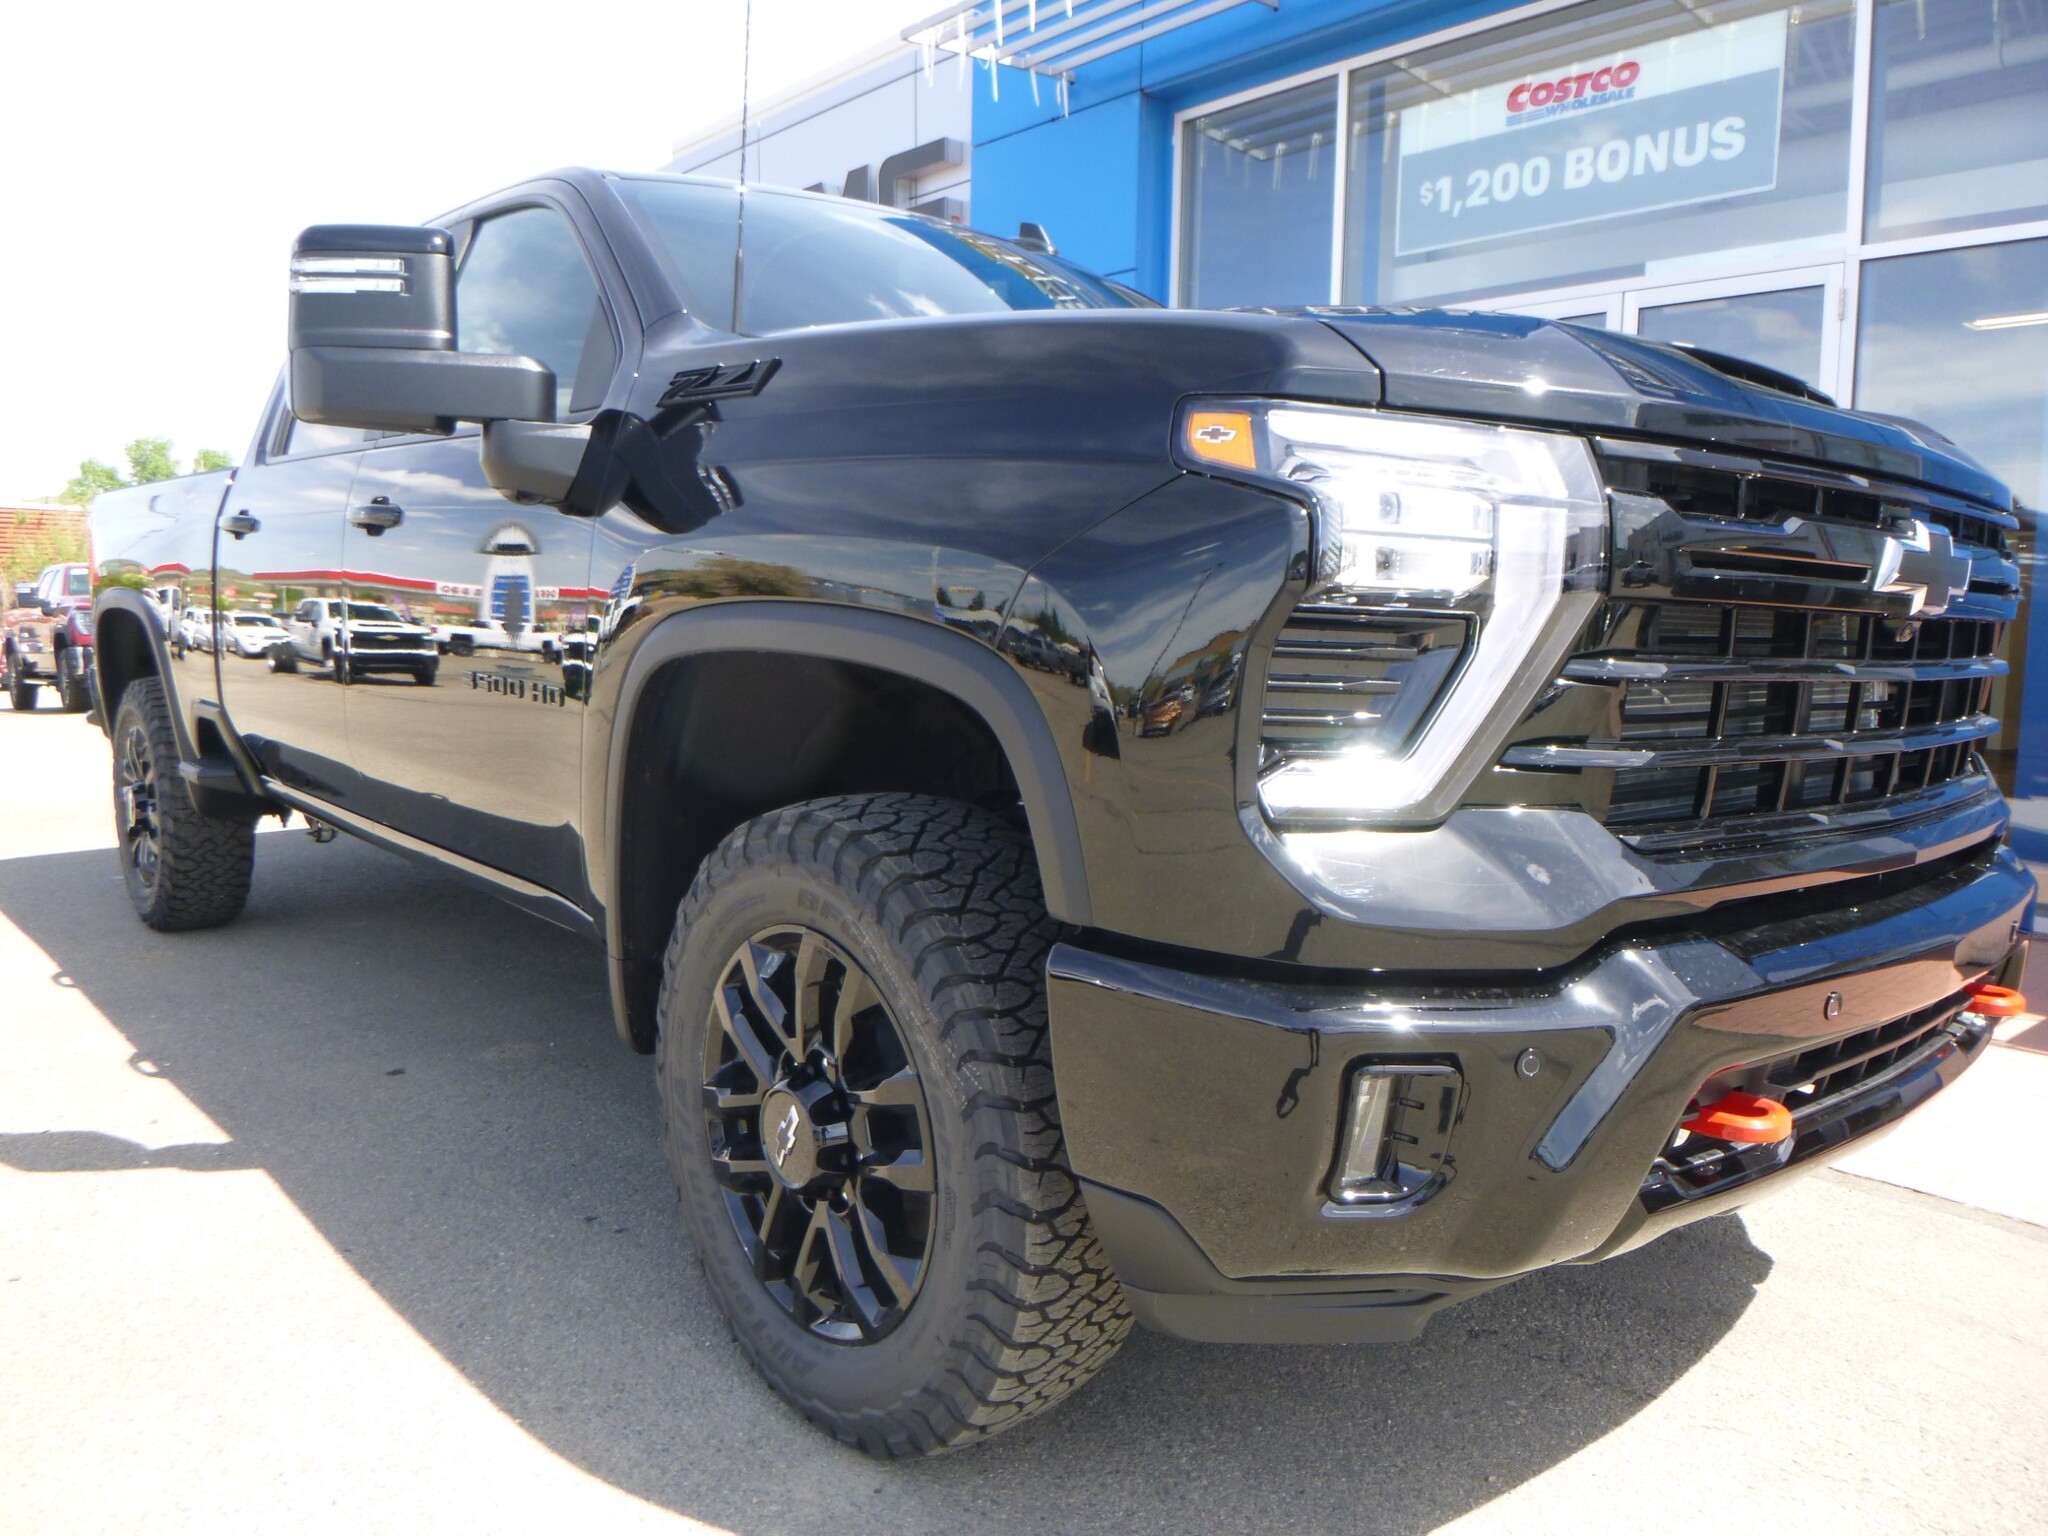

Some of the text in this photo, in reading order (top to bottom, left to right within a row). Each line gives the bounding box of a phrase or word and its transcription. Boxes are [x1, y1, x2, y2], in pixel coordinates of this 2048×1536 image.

[1506, 61, 1641, 113] COSTCO
[1544, 86, 1636, 118] WHOLESALE
[1419, 115, 1747, 218] $1,200 BONUS
[532, 681, 566, 708] HD
